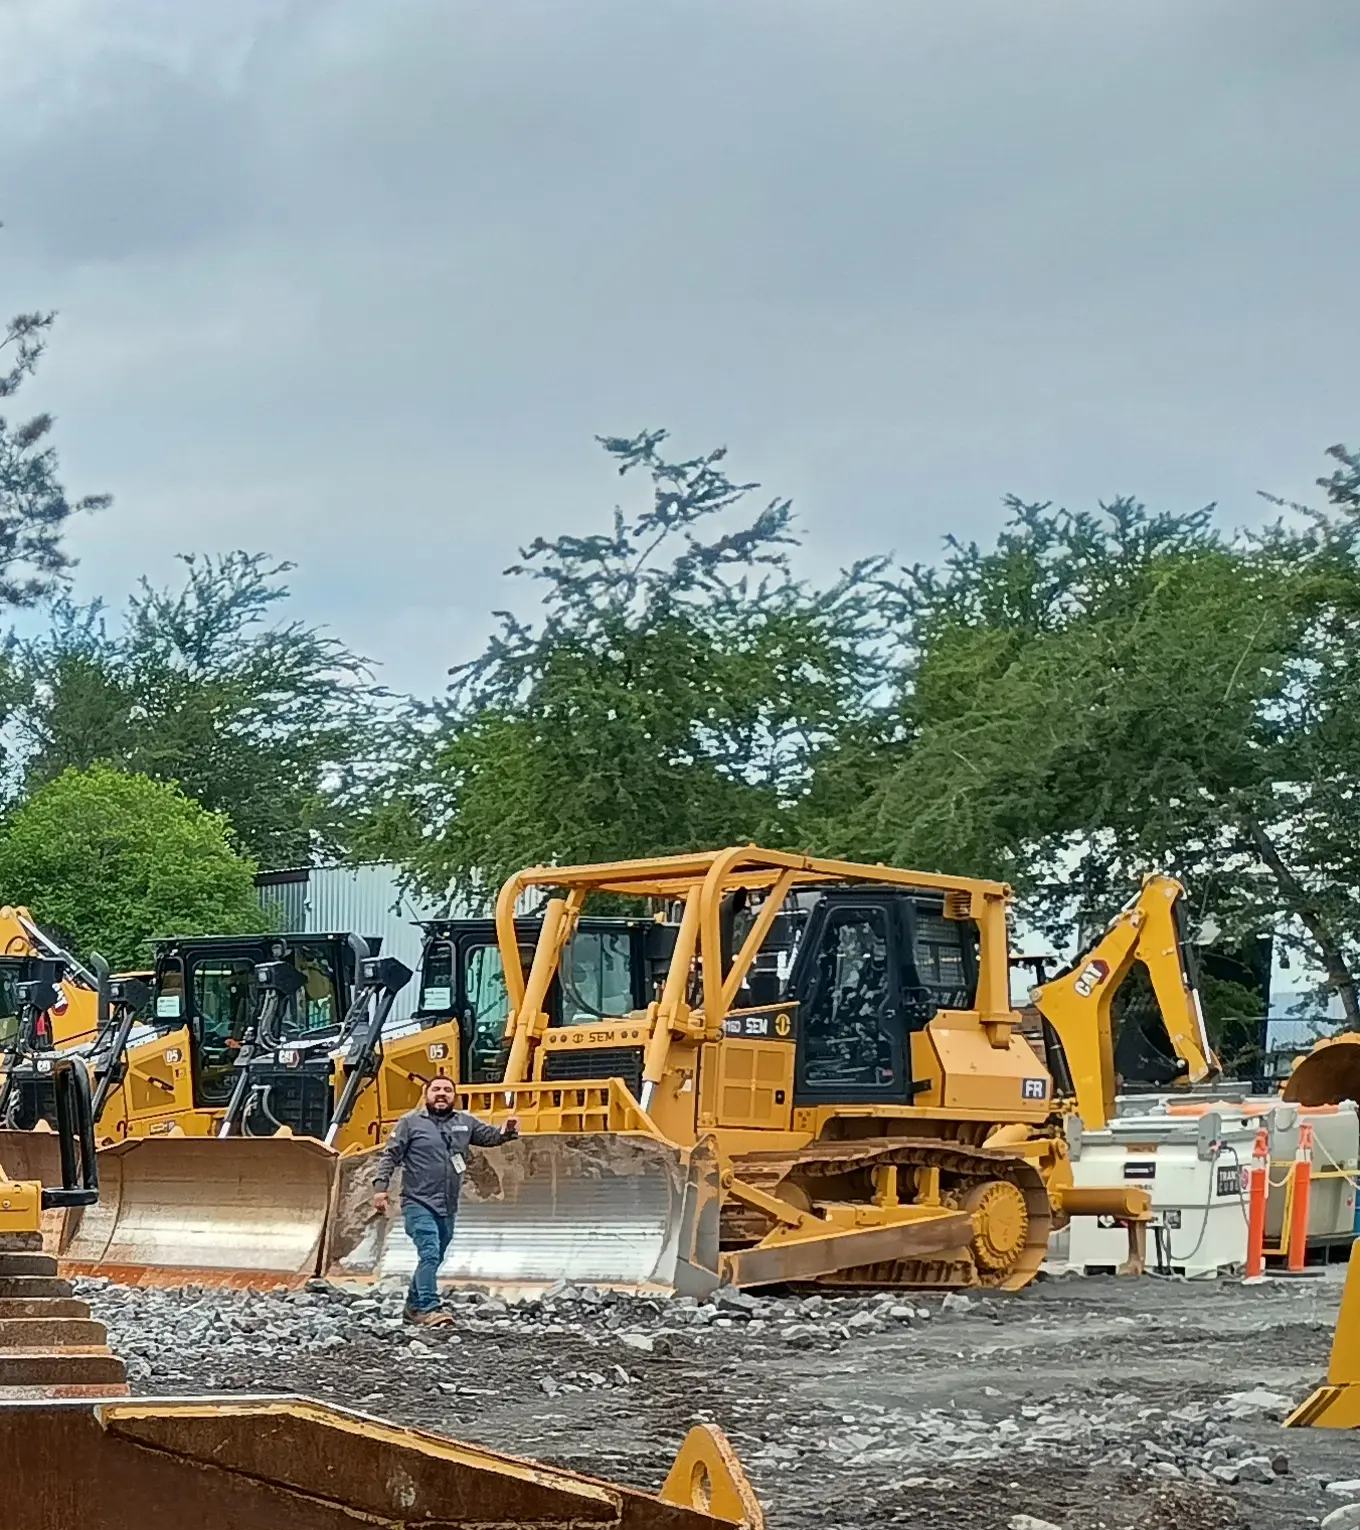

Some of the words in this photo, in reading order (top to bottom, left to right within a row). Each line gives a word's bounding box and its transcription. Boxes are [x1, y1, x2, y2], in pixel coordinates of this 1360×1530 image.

[1074, 962, 1103, 997] CAT
[745, 1017, 769, 1034] SEM
[589, 1031, 615, 1042] SEM
[1025, 1080, 1043, 1097] FR
